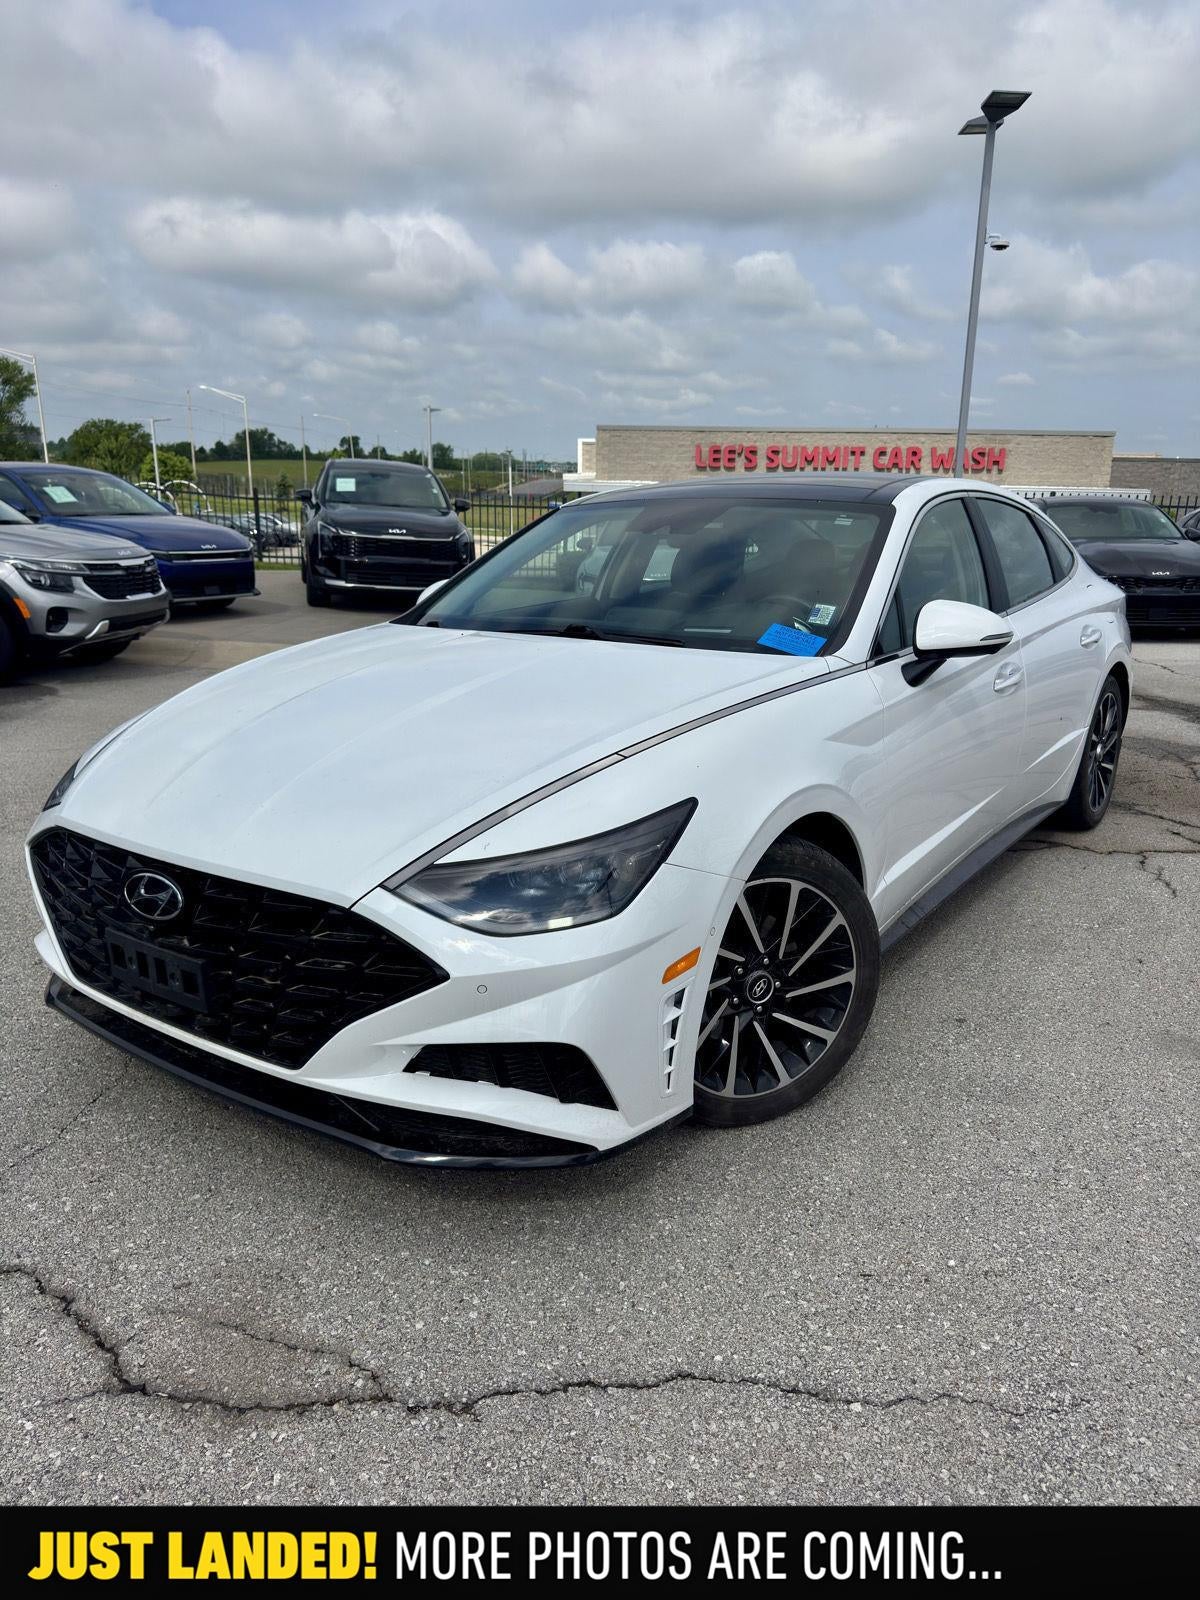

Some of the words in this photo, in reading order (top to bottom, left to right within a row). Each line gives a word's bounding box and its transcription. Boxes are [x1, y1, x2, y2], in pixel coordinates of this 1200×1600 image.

[694, 444, 758, 470] LEE'S
[765, 445, 867, 470] SUMMIT
[872, 446, 923, 471] CAR
